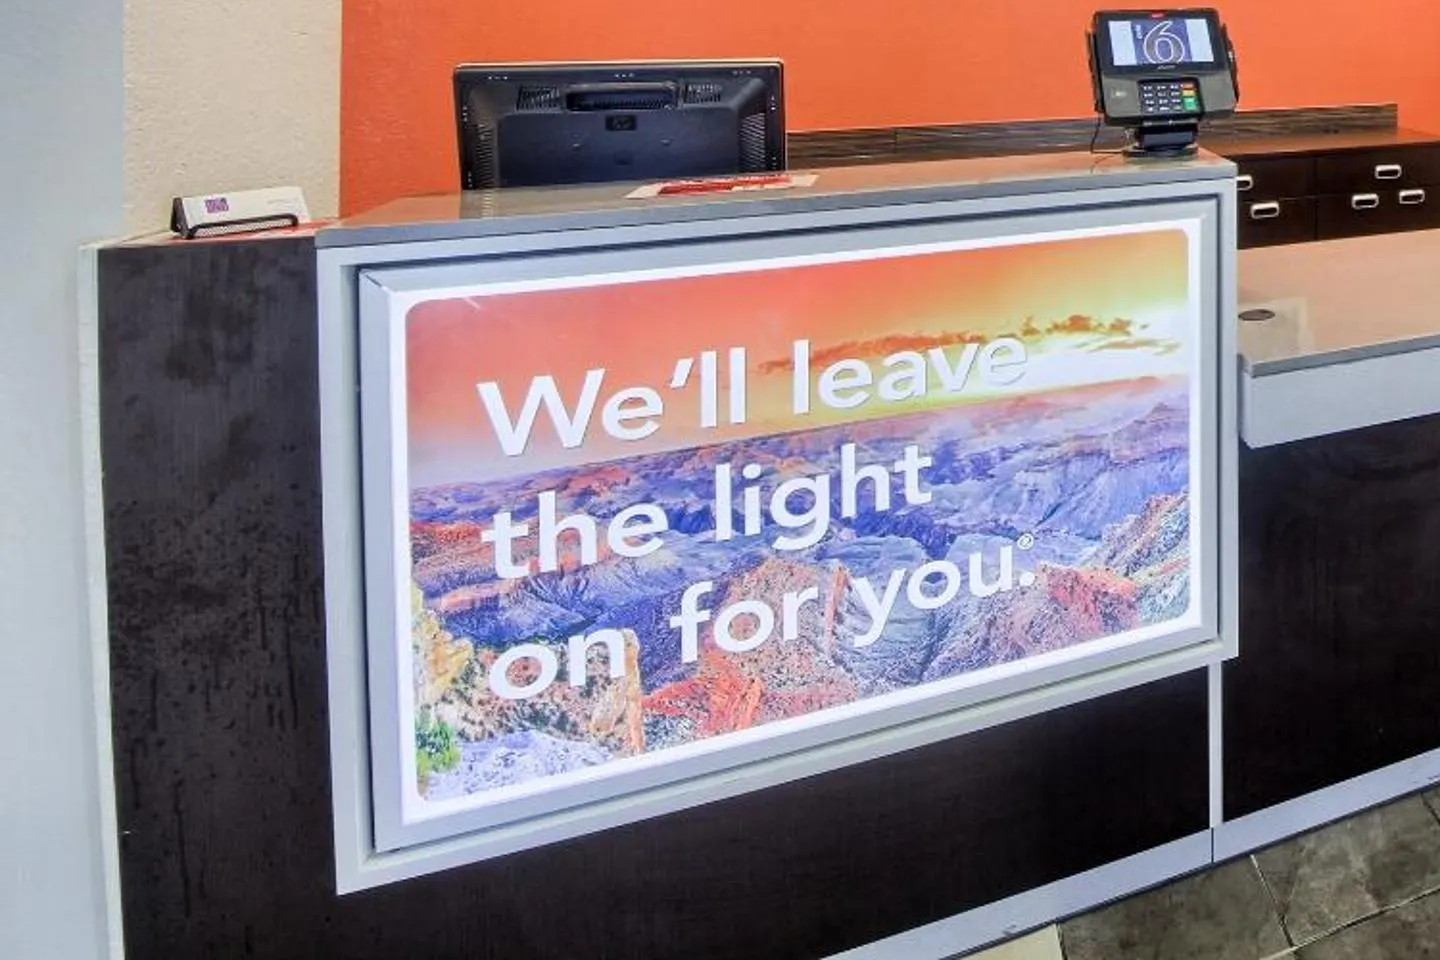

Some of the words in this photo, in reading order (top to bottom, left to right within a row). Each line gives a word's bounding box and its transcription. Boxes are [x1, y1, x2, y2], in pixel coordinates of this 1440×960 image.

[1143, 20, 1186, 64] 6
[476, 345, 746, 458] We'll
[793, 337, 1028, 416] leave
[480, 490, 669, 579] the
[714, 442, 933, 551] light
[489, 626, 627, 700] on
[669, 580, 819, 664] for
